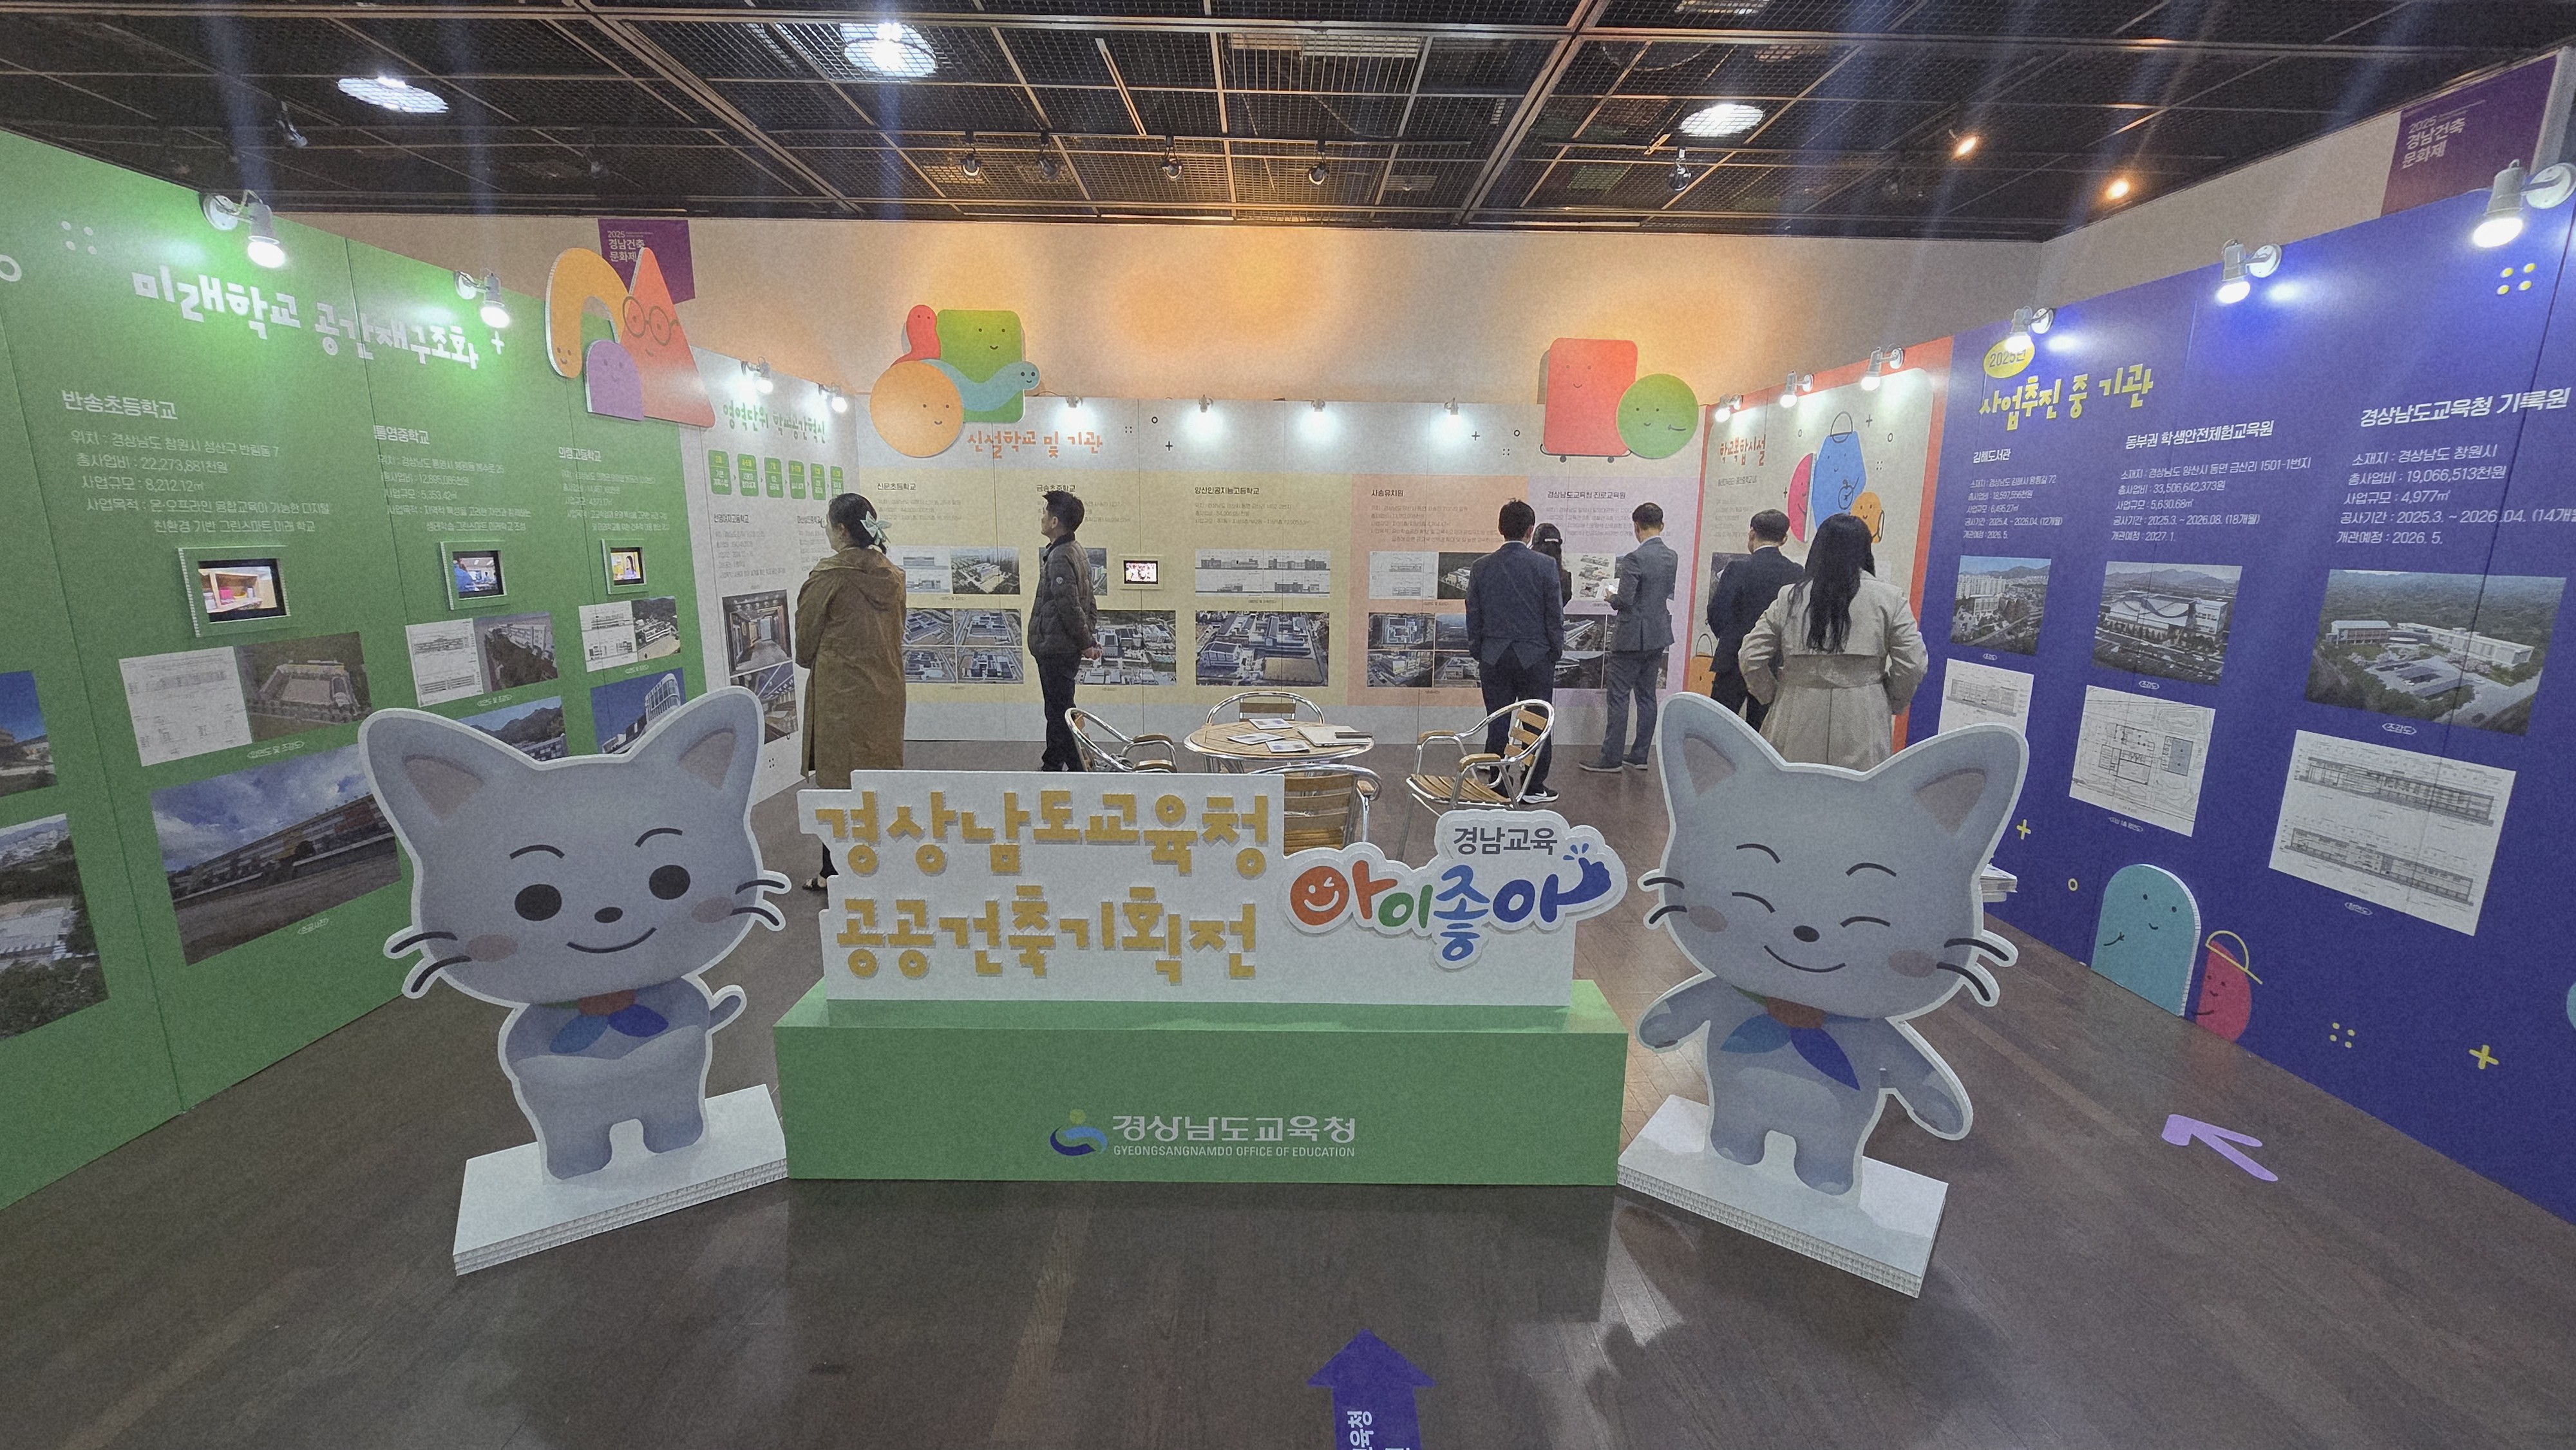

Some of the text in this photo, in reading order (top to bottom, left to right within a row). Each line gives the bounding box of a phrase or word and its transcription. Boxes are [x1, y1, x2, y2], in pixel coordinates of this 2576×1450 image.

[2407, 117, 2466, 149] 경남건축
[2409, 116, 2438, 133] 2025
[2402, 140, 2447, 169] 문화제
[609, 239, 645, 250] 경남건축
[132, 265, 479, 370] 미래학교 공간재구조화
[62, 390, 178, 420] 반송초등학교
[1979, 363, 2154, 431] 사업추진 중 기관
[2360, 387, 2571, 428] 경상남도교육청 기록원
[723, 399, 769, 432] 영역단위
[71, 430, 99, 445] 위치
[112, 433, 162, 450] 경상남도
[165, 437, 201, 452] 창원시
[204, 441, 236, 455] 성산구
[373, 424, 430, 446] 통영중학교
[967, 430, 1103, 460] 신설학교 및 기관
[2125, 420, 2275, 450] 동부권 학생안전체험교육원
[558, 446, 601, 462] 의령고등학교
[1719, 433, 1766, 467] 학교복합시설
[1973, 448, 2011, 464] 김해도서관
[2352, 444, 2498, 466] 소재지 경상남도 창원시
[76, 453, 228, 474] 총사업비 22,273,881천원
[2120, 457, 2312, 480] 소재지 경상남도 양산시 동면 금산리 1501-1번지
[82, 476, 135, 490] 사업규모
[2048, 475, 2057, 484] 72
[2348, 466, 2506, 486] 총사업비 19,066,513천원
[2117, 480, 2226, 495] 총사업비 33,506,642,373원
[2344, 489, 2451, 505] 사업규모 4,977㎡
[87, 498, 139, 511] 사업목적
[270, 502, 299, 514] 가능한
[301, 502, 330, 514] 디지털
[2116, 498, 2194, 511] 사업규모 5,630.68㎡
[154, 520, 191, 533] 친환경
[193, 520, 216, 533] 기반
[220, 520, 272, 533] 그린스마트
[296, 520, 316, 532] 학교
[2113, 513, 2260, 526] 공사기간 2025.3. 2026.08. (18개월)
[2340, 511, 2387, 524] 공사기간
[2396, 510, 2445, 523] 2025.3.
[2459, 509, 2526, 523] 2026.04.
[2111, 531, 2140, 541] 개관예정
[2145, 531, 2168, 541] 2027.
[2336, 531, 2443, 544] 개관예정 2026. 5.
[815, 791, 1269, 880] 경상남도교육청
[1454, 827, 1557, 856] 경남교육
[1290, 857, 1611, 961] 아이좋아
[837, 885, 1256, 986] 공공건축기획전
[1112, 1115, 1355, 1144] 경상남도교육청
[1113, 1145, 1355, 1157] GYEONGSANGNAMDO OFFICE OF EDUCATION
[1347, 1411, 1374, 1450] 육청
